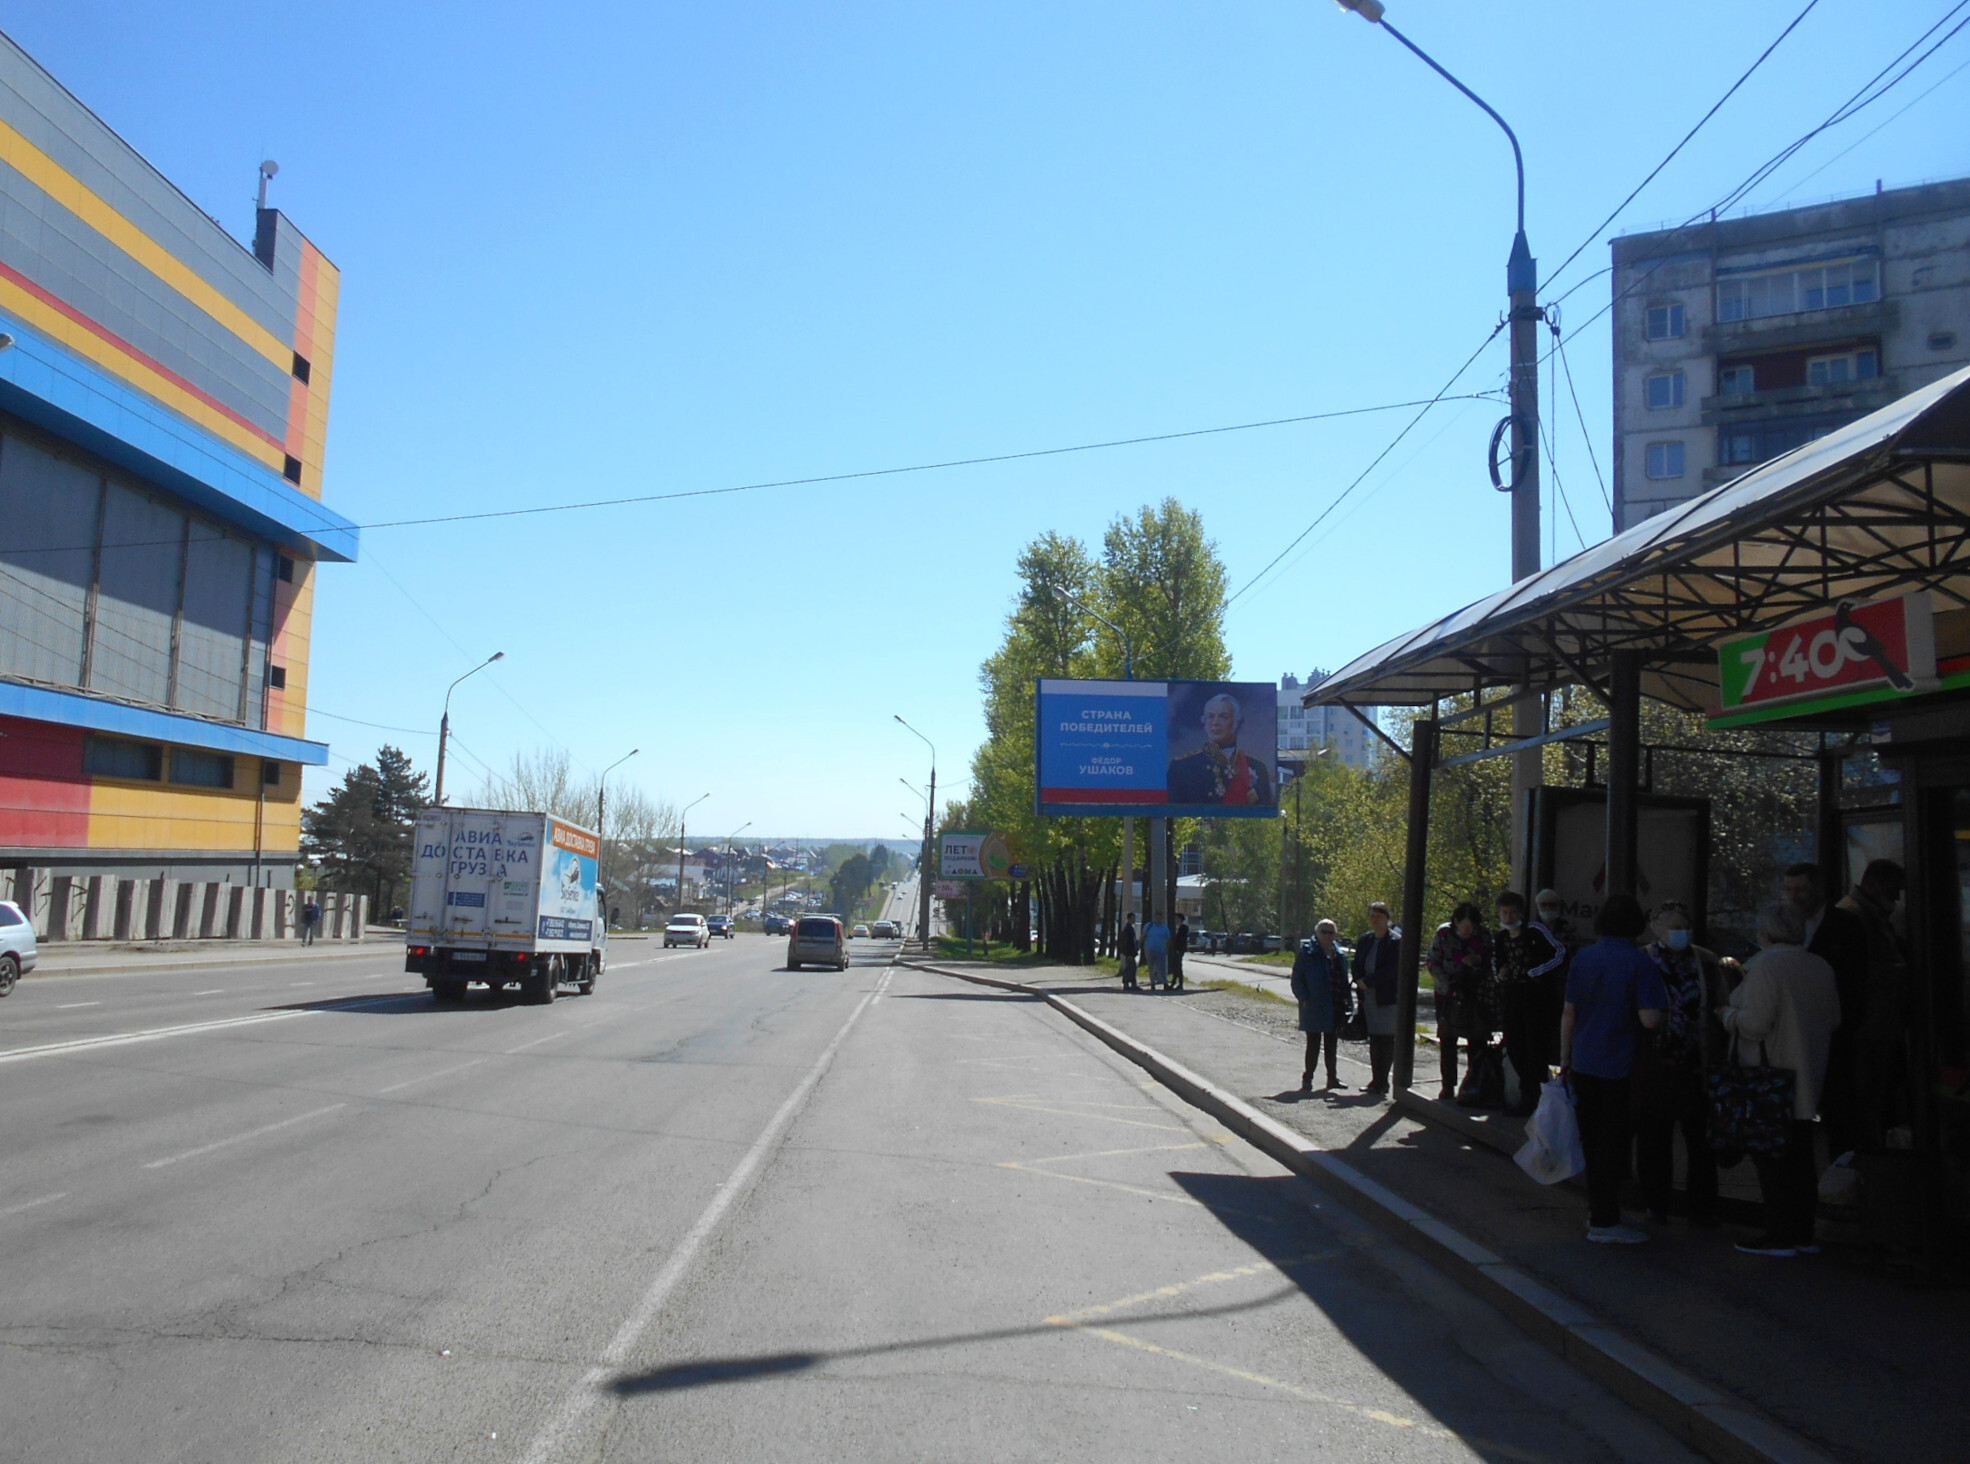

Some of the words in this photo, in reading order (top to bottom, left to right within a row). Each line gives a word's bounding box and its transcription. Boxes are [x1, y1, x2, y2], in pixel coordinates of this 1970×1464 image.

[1081, 710, 1132, 721] СТРАНА
[1060, 720, 1153, 733] ПОБЕДИТЕЛЕЙ
[1079, 765, 1134, 775] УШАКОВ
[455, 830, 502, 847] АВИА
[450, 860, 508, 878] ГРУЗА
